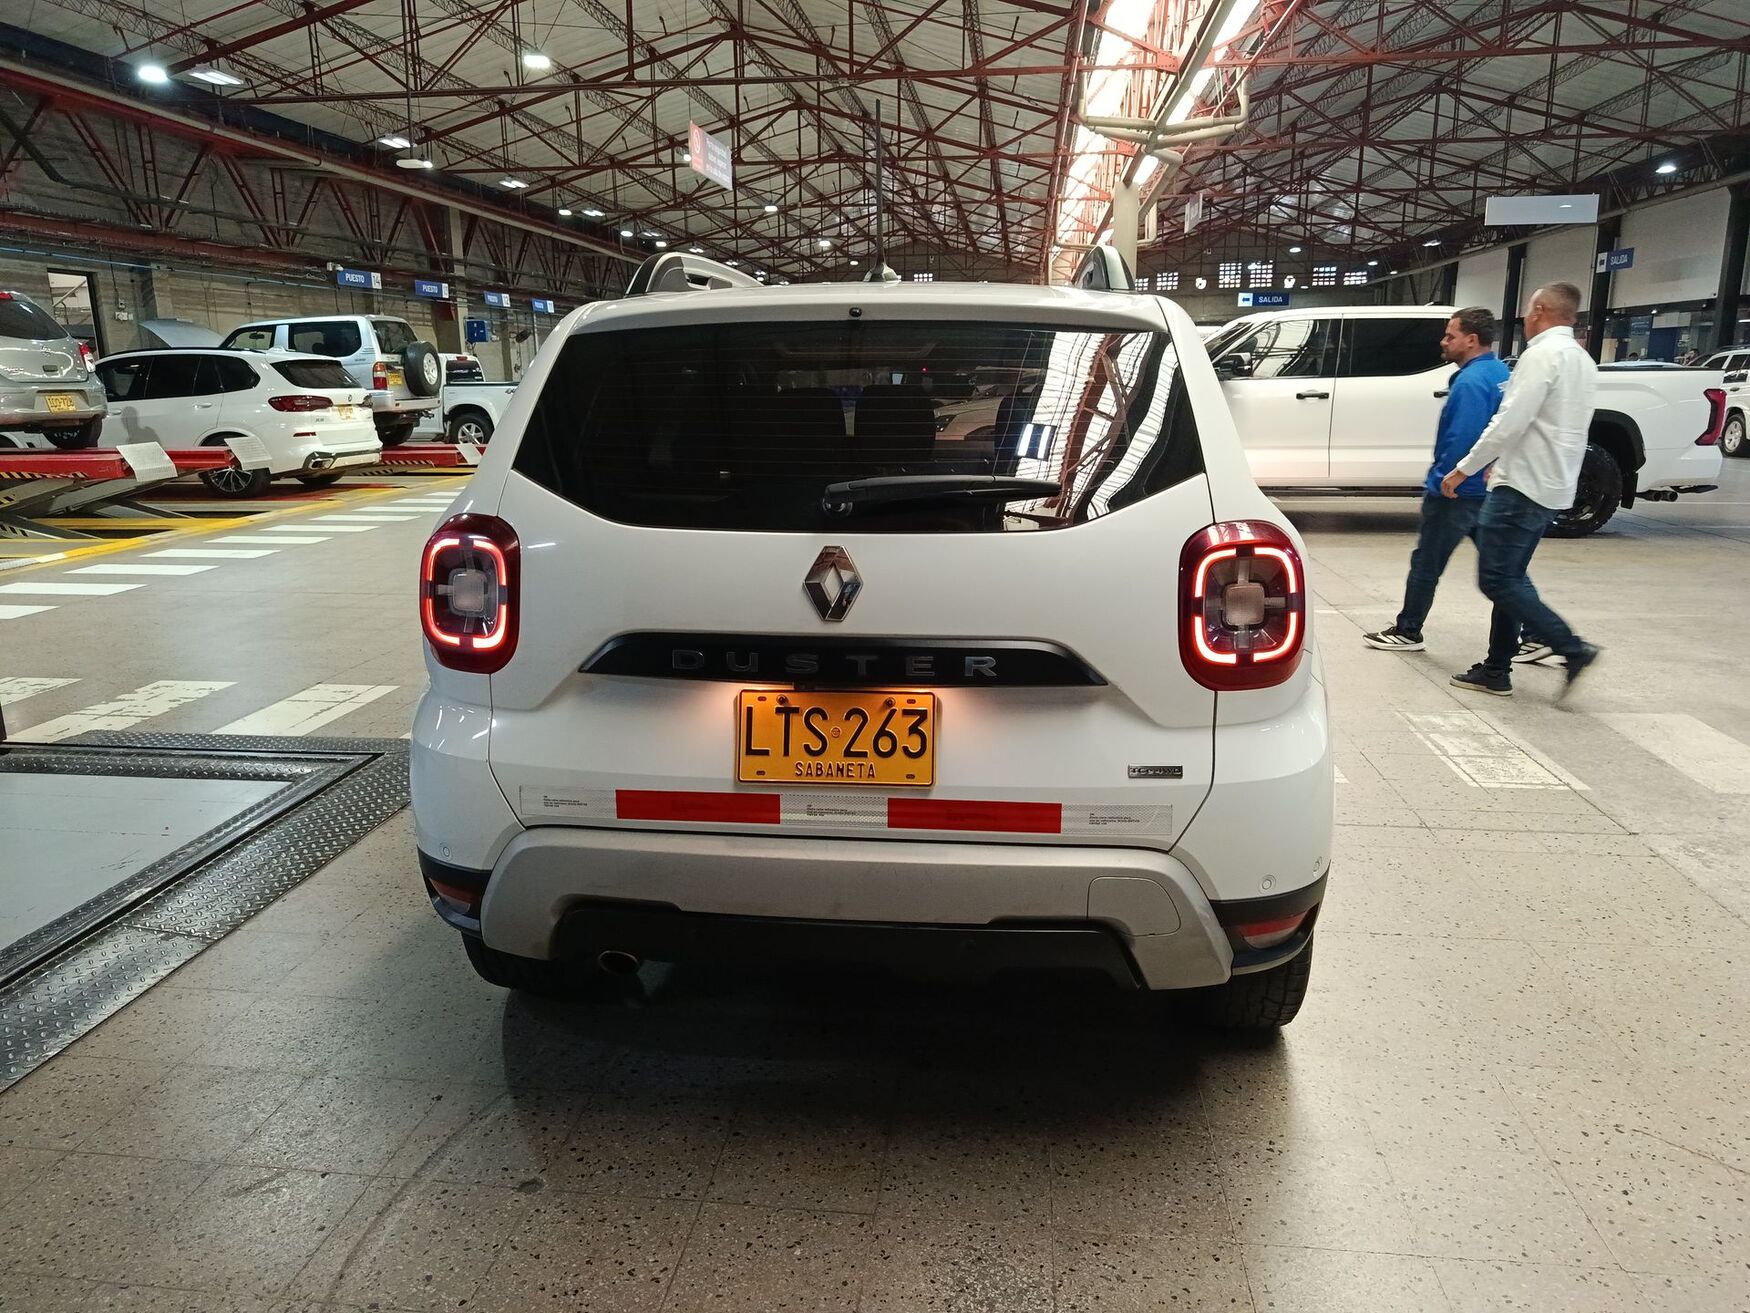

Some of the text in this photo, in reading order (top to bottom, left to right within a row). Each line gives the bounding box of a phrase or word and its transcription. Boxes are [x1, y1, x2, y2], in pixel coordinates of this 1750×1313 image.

[1610, 254, 1628, 265] SALIDA
[345, 272, 381, 285] PUESTO 14
[1258, 295, 1283, 303] SALIDA
[671, 649, 998, 678] DUSTER
[795, 761, 876, 779] SABANETA
